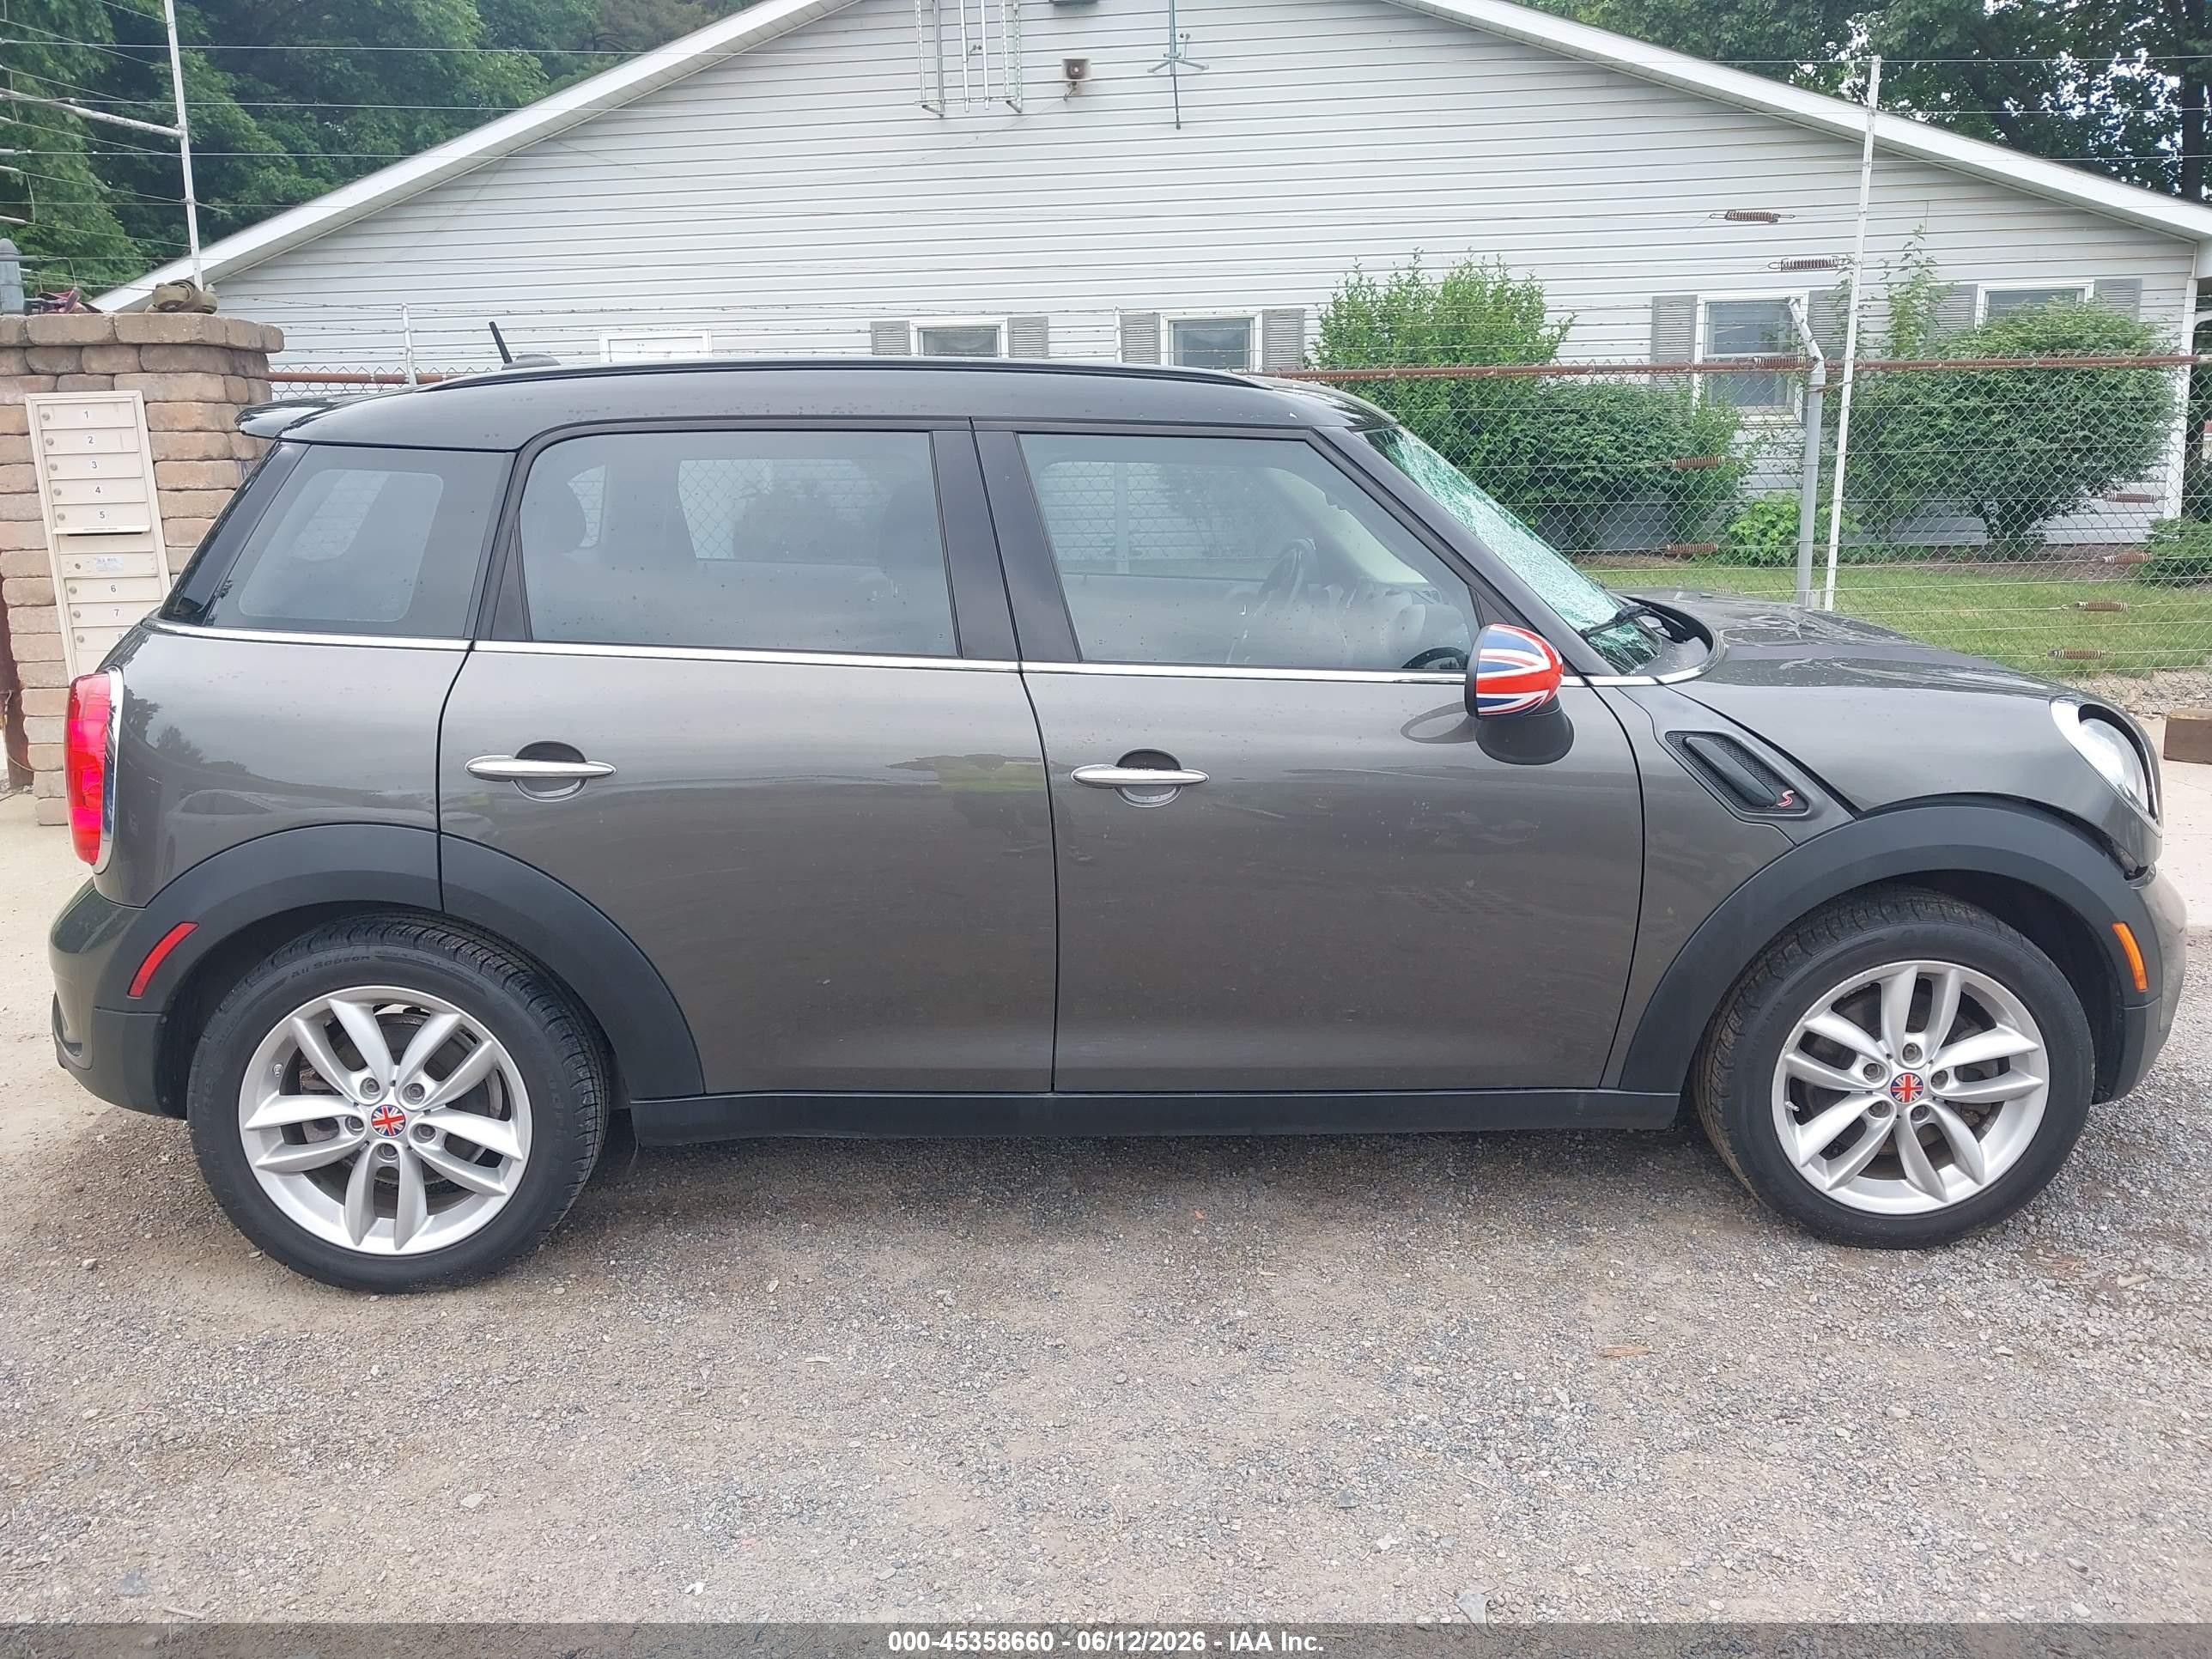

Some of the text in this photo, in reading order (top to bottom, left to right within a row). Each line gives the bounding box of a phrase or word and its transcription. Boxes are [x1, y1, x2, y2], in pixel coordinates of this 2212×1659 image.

[88, 435, 94, 444] 2
[91, 460, 98, 469] 3
[99, 510, 105, 519] 5
[110, 584, 116, 592] 6
[113, 608, 119, 617] 7
[1777, 789, 1796, 807] S
